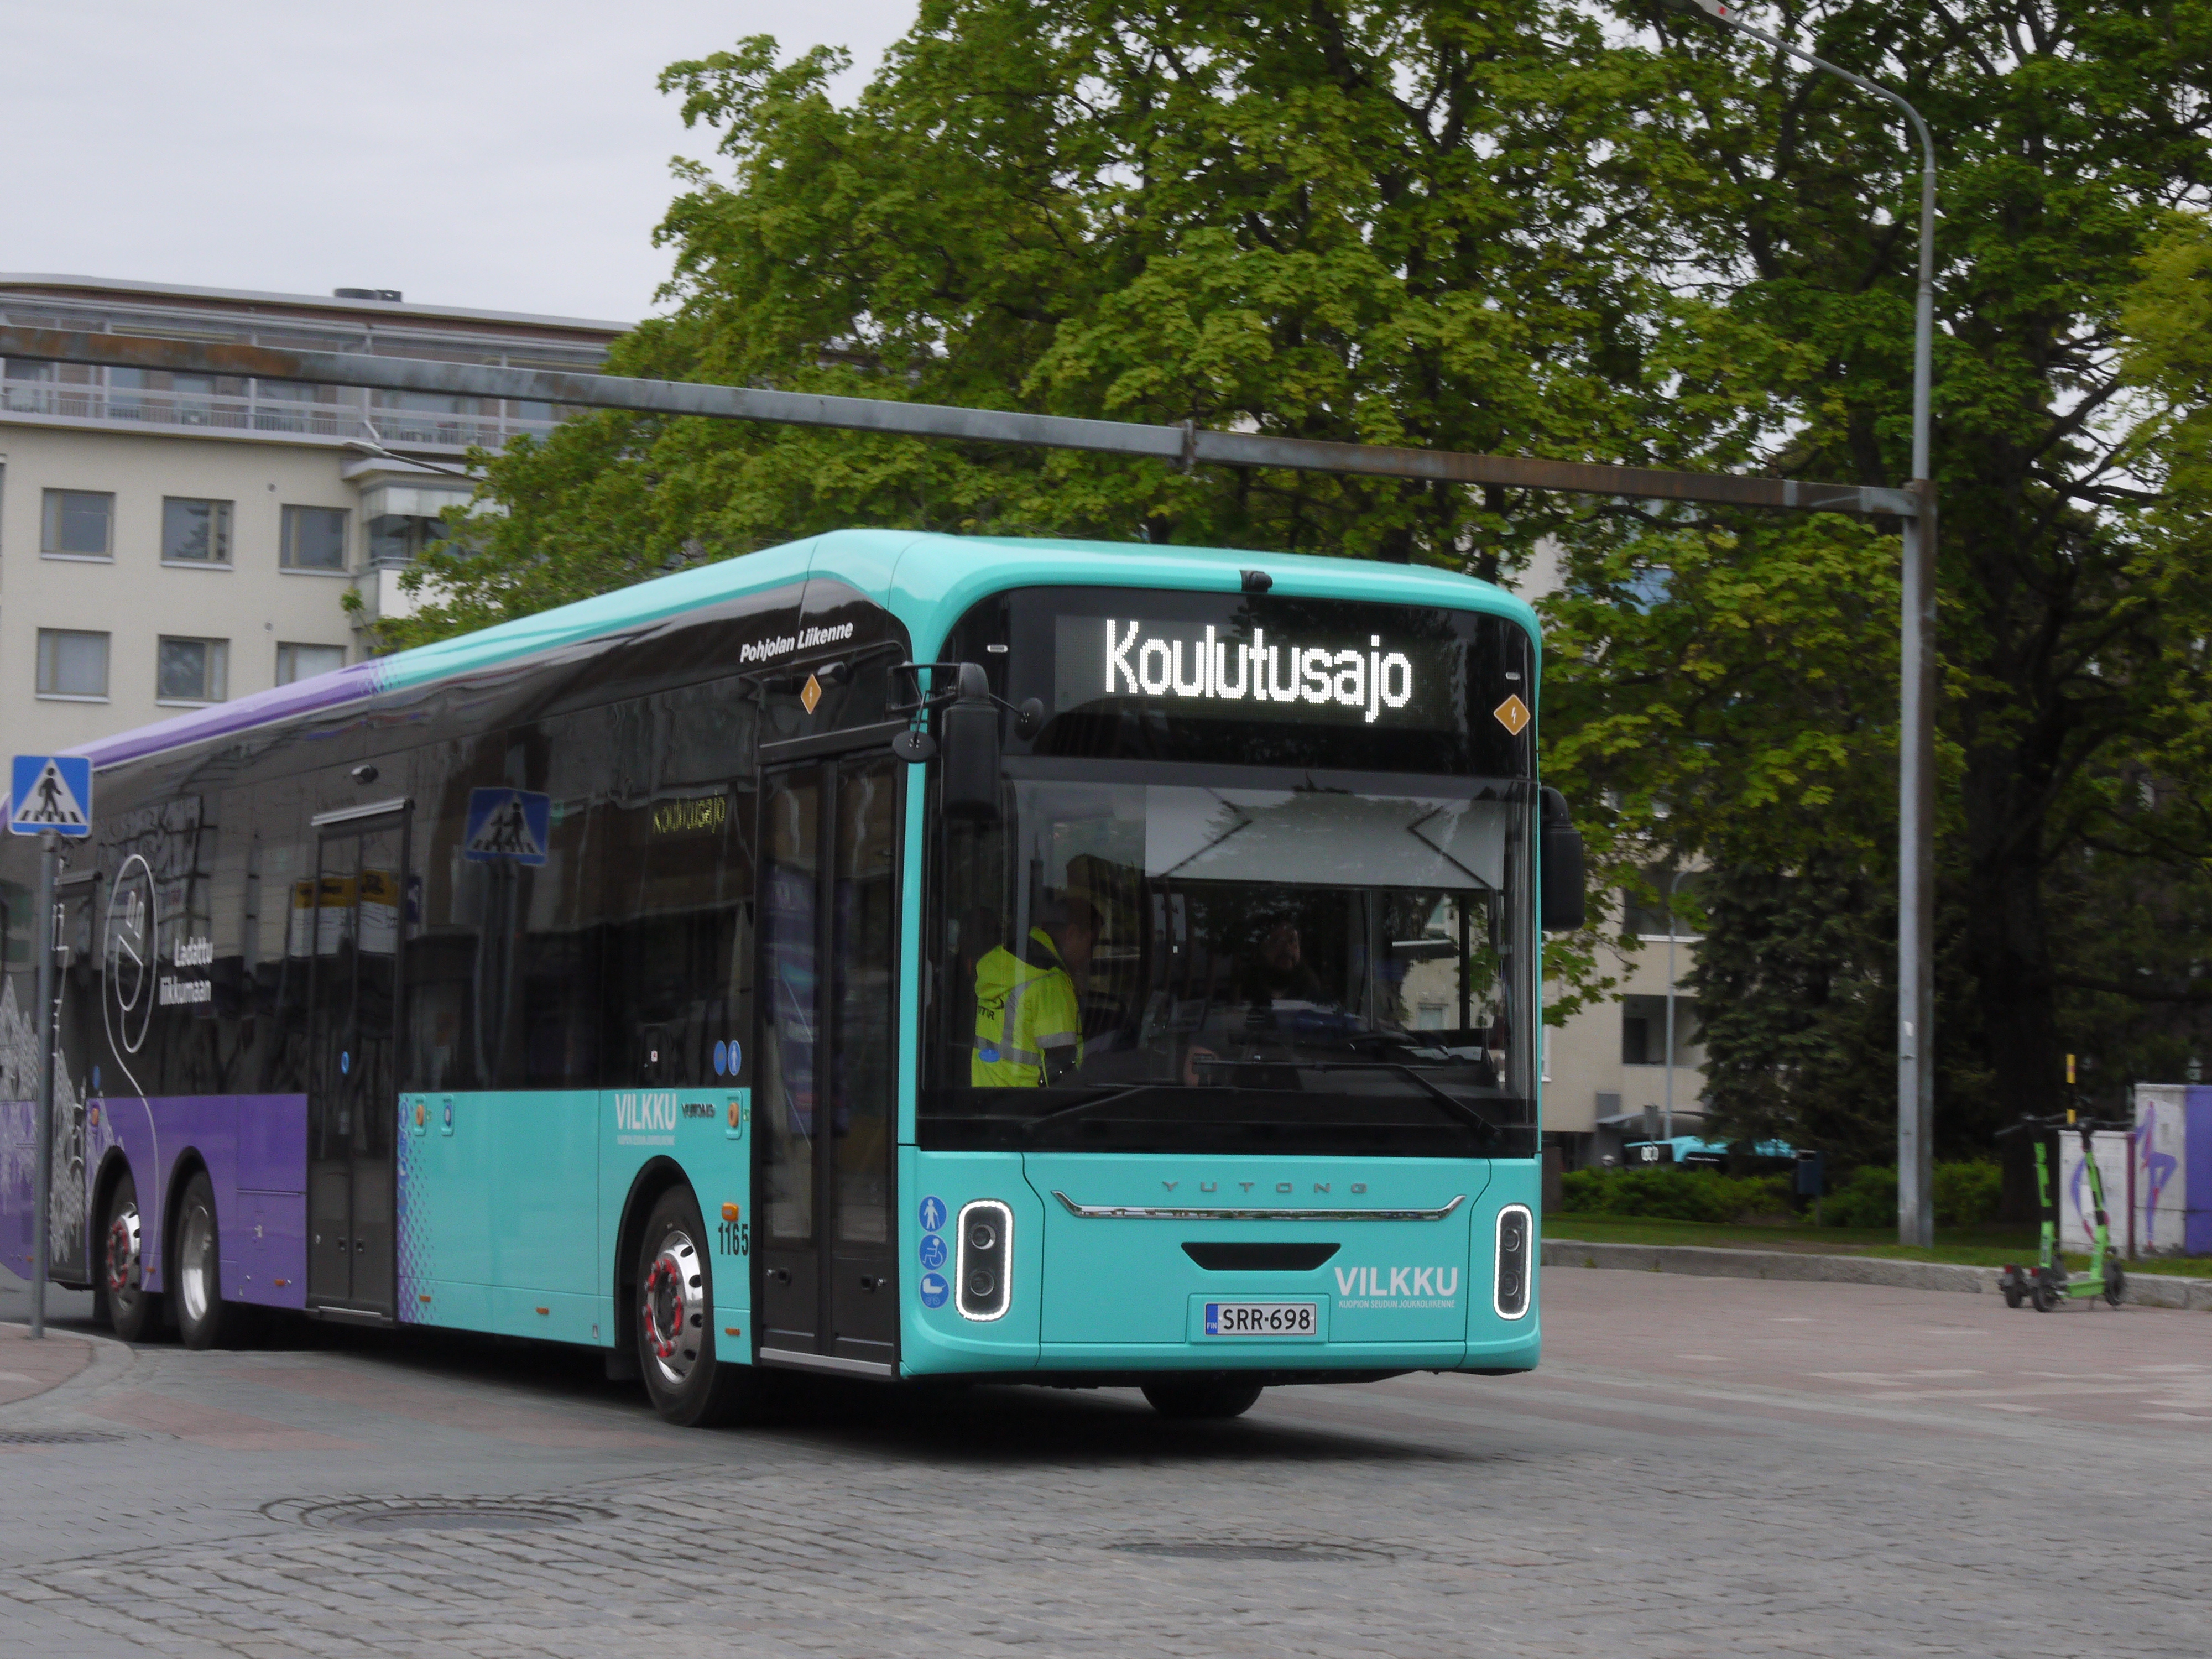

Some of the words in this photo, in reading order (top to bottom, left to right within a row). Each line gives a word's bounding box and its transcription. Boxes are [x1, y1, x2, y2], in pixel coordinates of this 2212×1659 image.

[739, 635, 795, 663] Pohjolan
[797, 622, 854, 650] Liikenne
[1106, 619, 1411, 723] Koulutusajo
[174, 936, 213, 967] Ladattu
[159, 975, 211, 1005] liikkumaan
[615, 1093, 677, 1130] VILKKU
[1162, 1181, 1368, 1193] YUTONG
[718, 1222, 749, 1256] 1165
[1334, 1267, 1458, 1296] VILKKU
[1223, 1308, 1311, 1330] SRR-698
[1339, 1300, 1369, 1308] KUOPION
[1370, 1300, 1398, 1308] SEUDUN
[1399, 1300, 1455, 1308] JOUKKOLIIKENNE
